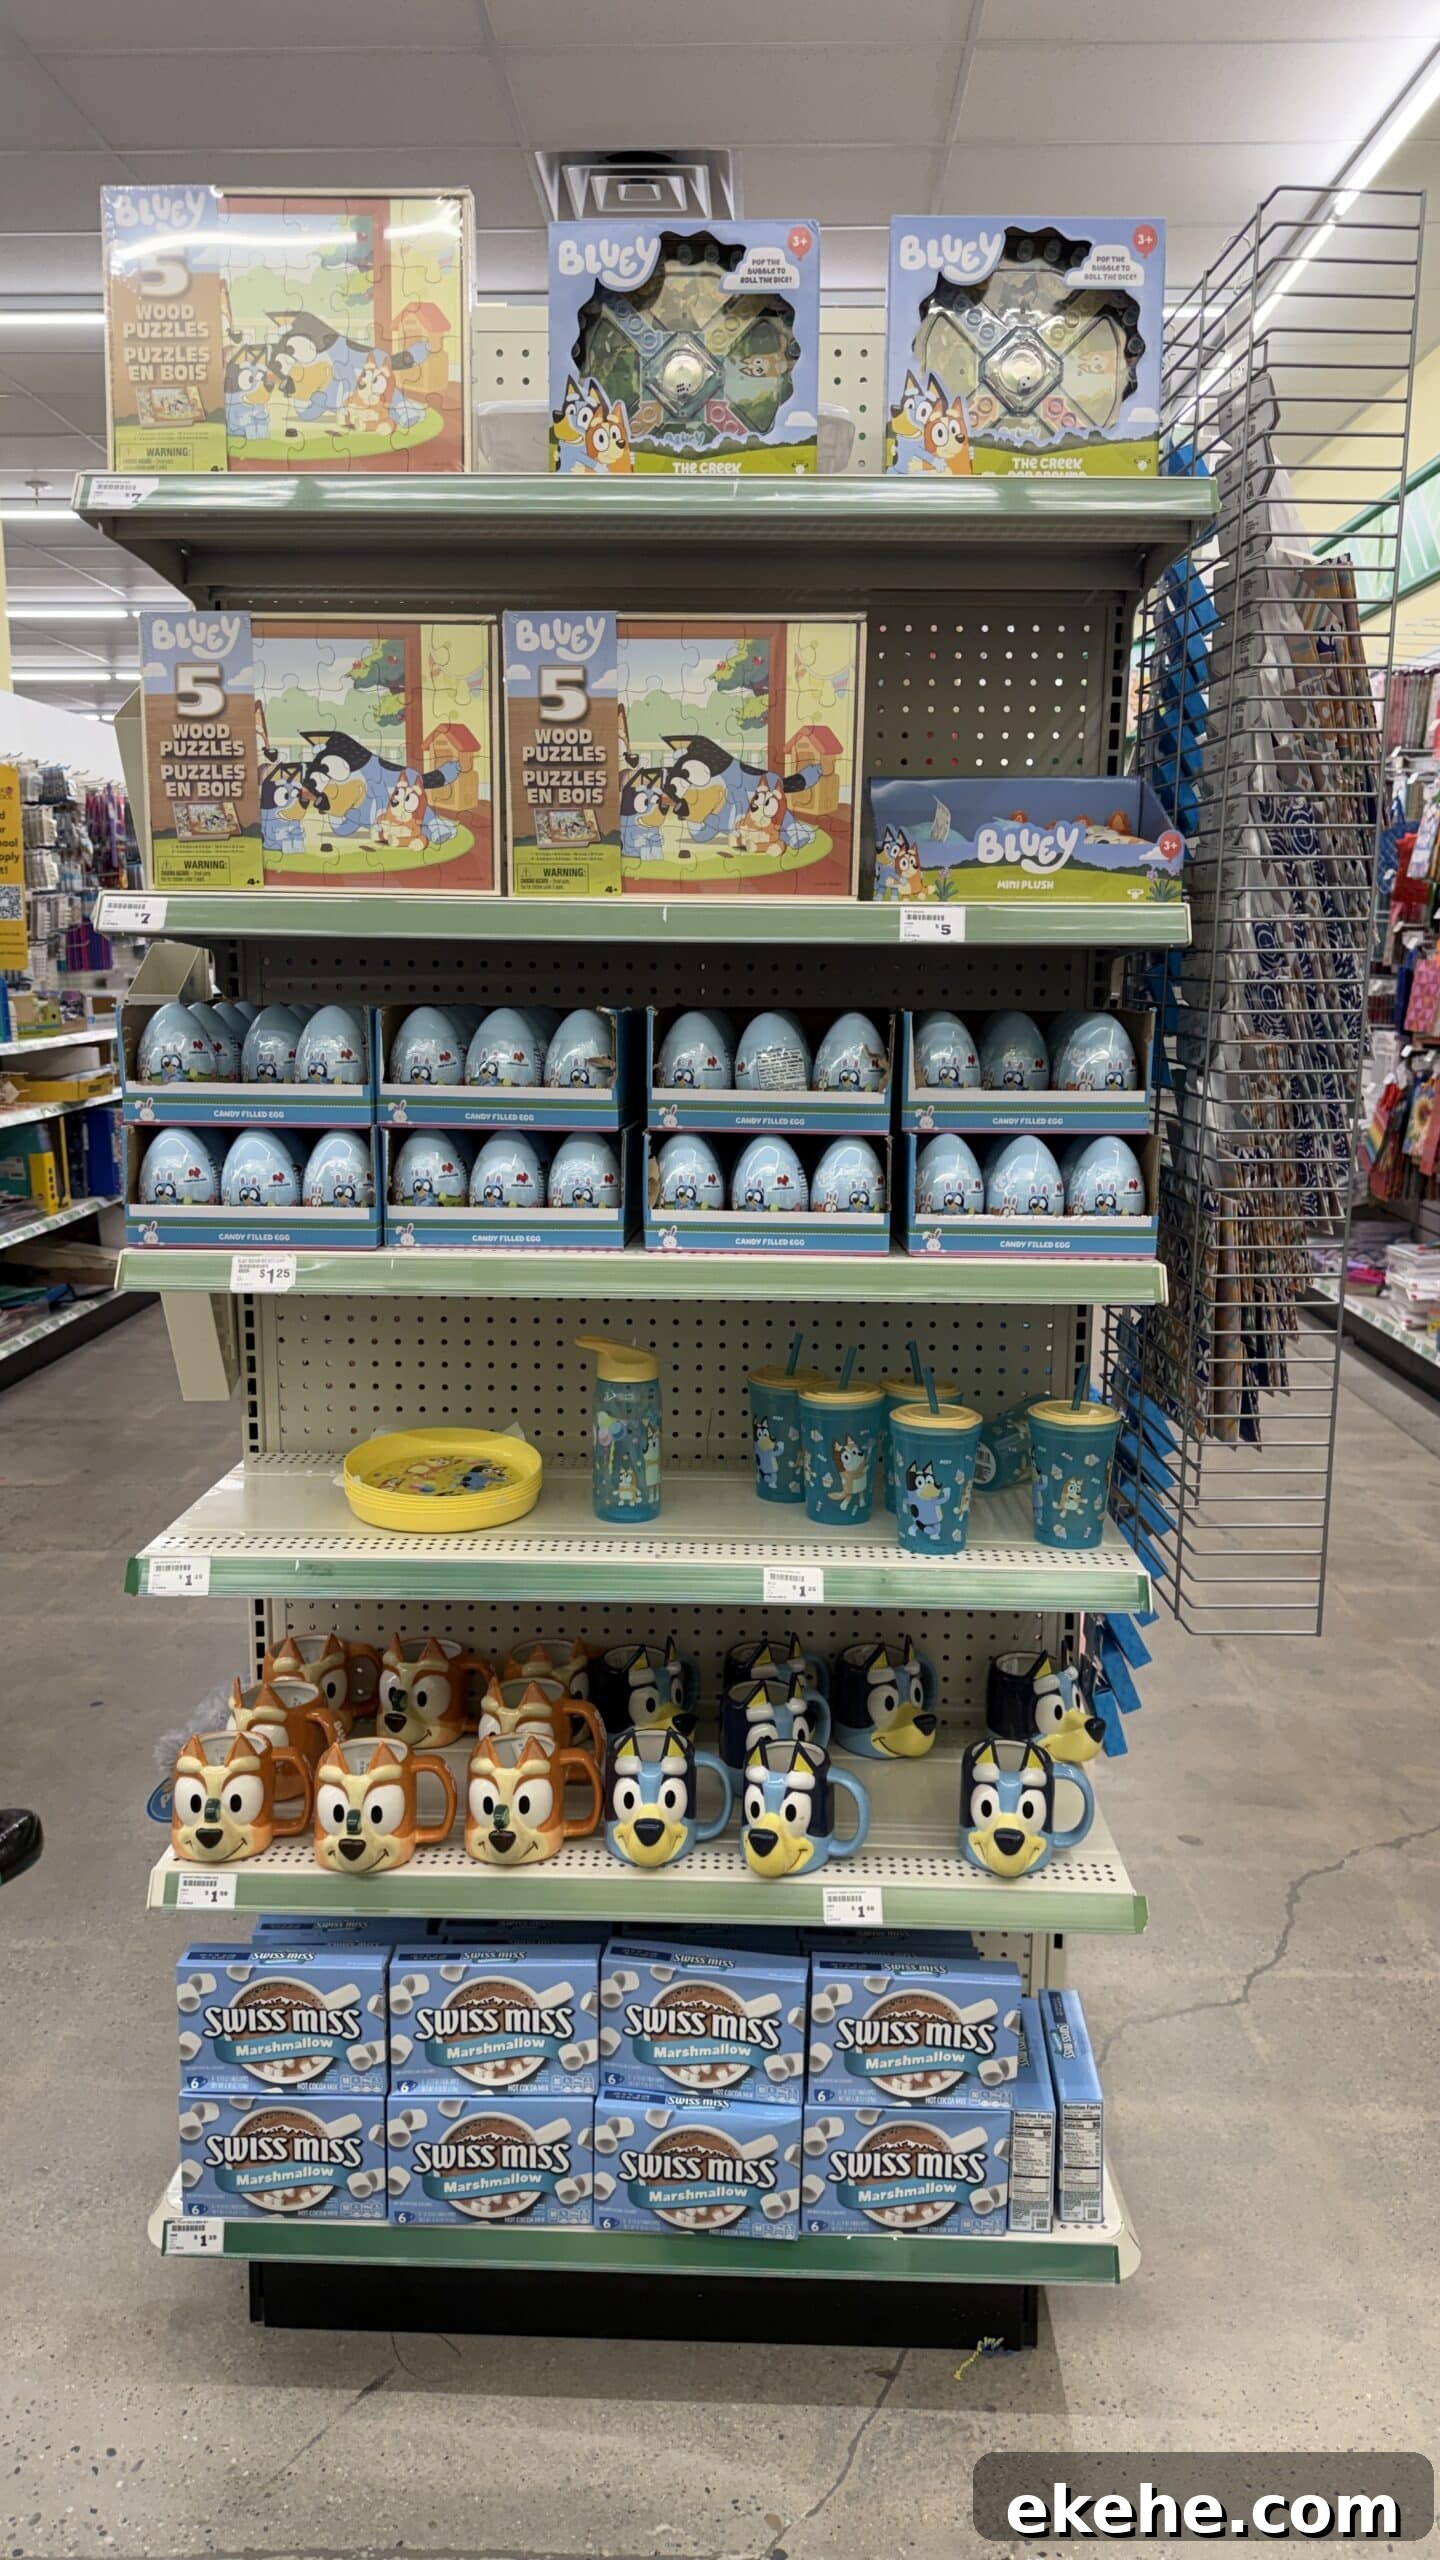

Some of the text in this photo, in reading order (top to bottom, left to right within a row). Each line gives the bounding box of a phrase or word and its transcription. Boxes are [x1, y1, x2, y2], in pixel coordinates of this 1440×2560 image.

[792, 236, 808, 248] 3+
[1137, 234, 1153, 245] 3+
[558, 236, 660, 288] BLUEY
[899, 232, 1001, 284] BLUEY
[1096, 255, 1125, 263] POP THE
[139, 245, 189, 297] 5
[747, 267, 776, 275] BUBBLE
[1103, 273, 1118, 281] THE
[758, 276, 773, 284] THE
[136, 304, 195, 321] WOOD
[122, 321, 209, 338] PUZZLES
[124, 345, 210, 363] PUZZLES
[128, 364, 208, 381] EN BOIS
[146, 447, 191, 457] WARNING:
[673, 462, 742, 474] THE CREEK
[1012, 457, 1083, 470] THE CREEK
[151, 615, 241, 660] BLUEY
[516, 615, 606, 662] BLUEY
[175, 664, 225, 718] 5
[538, 666, 588, 722] 5
[172, 723, 230, 739] WOOD
[534, 728, 593, 745] WOOD
[160, 740, 245, 756] PUZZLES
[522, 746, 607, 762] PUZZLES
[160, 764, 246, 780] PUZZLES
[522, 770, 607, 787] PUZZLES
[166, 781, 243, 798] EN BOIS
[527, 787, 604, 804] EN BOIS
[977, 826, 1079, 874] BLUEY
[1163, 841, 1178, 850] 3+
[183, 860, 228, 870] WARNING:
[543, 867, 586, 877] WARNING:
[997, 879, 1055, 890] MINI PLUSH
[213, 1110, 240, 1118] CANDY
[268, 1111, 284, 1119] EGG
[465, 1112, 492, 1120] CANDY
[762, 1117, 789, 1125] FILLED
[992, 1117, 1063, 1125] CANDY FILLED EGG
[219, 1233, 246, 1241] CANDY
[246, 1233, 274, 1241] FILLED
[472, 1234, 499, 1242] CANDY
[499, 1234, 525, 1242] FILLED
[762, 1238, 789, 1246] FILLED
[1000, 1240, 1027, 1248] CANDY
[1054, 1241, 1070, 1249] EGG
[251, 1952, 315, 1960] SWISS MISS
[463, 1952, 496, 1960] SWISS
[673, 1953, 735, 1968] SWISS MISS
[883, 1963, 946, 1974] SWISS MISS
[204, 2006, 363, 2040] SWISS MISS
[415, 2007, 575, 2040] SWISS MISS
[623, 2004, 781, 2049] SWISS MISS
[835, 2019, 920, 2049] SWISS
[925, 2022, 997, 2055] MISS
[235, 2038, 334, 2057] Marshmallow
[446, 2038, 545, 2060] Marshmallow
[654, 2044, 751, 2059] Marshmallow
[865, 2050, 965, 2071] Marshmallow
[191, 2078, 199, 2089] 6
[608, 2074, 616, 2085] 6
[400, 2082, 409, 2093] 6
[666, 2095, 730, 2108] SWISS MISS
[817, 2091, 826, 2102] 6
[204, 2134, 363, 2168] SWISS MISS
[412, 2142, 571, 2174] SWISS MISS
[619, 2150, 777, 2189] SWISS MISS
[827, 2151, 911, 2182] SWISS
[917, 2152, 988, 2184] MISS
[236, 2166, 334, 2186] Marshmallow
[443, 2173, 542, 2193] Marshmallow
[649, 2186, 748, 2203] Marshmallow
[858, 2182, 957, 2202] Marshmallow
[191, 2205, 199, 2215] 6
[398, 2212, 406, 2223] 6
[603, 2219, 611, 2229] 6
[810, 2220, 819, 2231] 6
